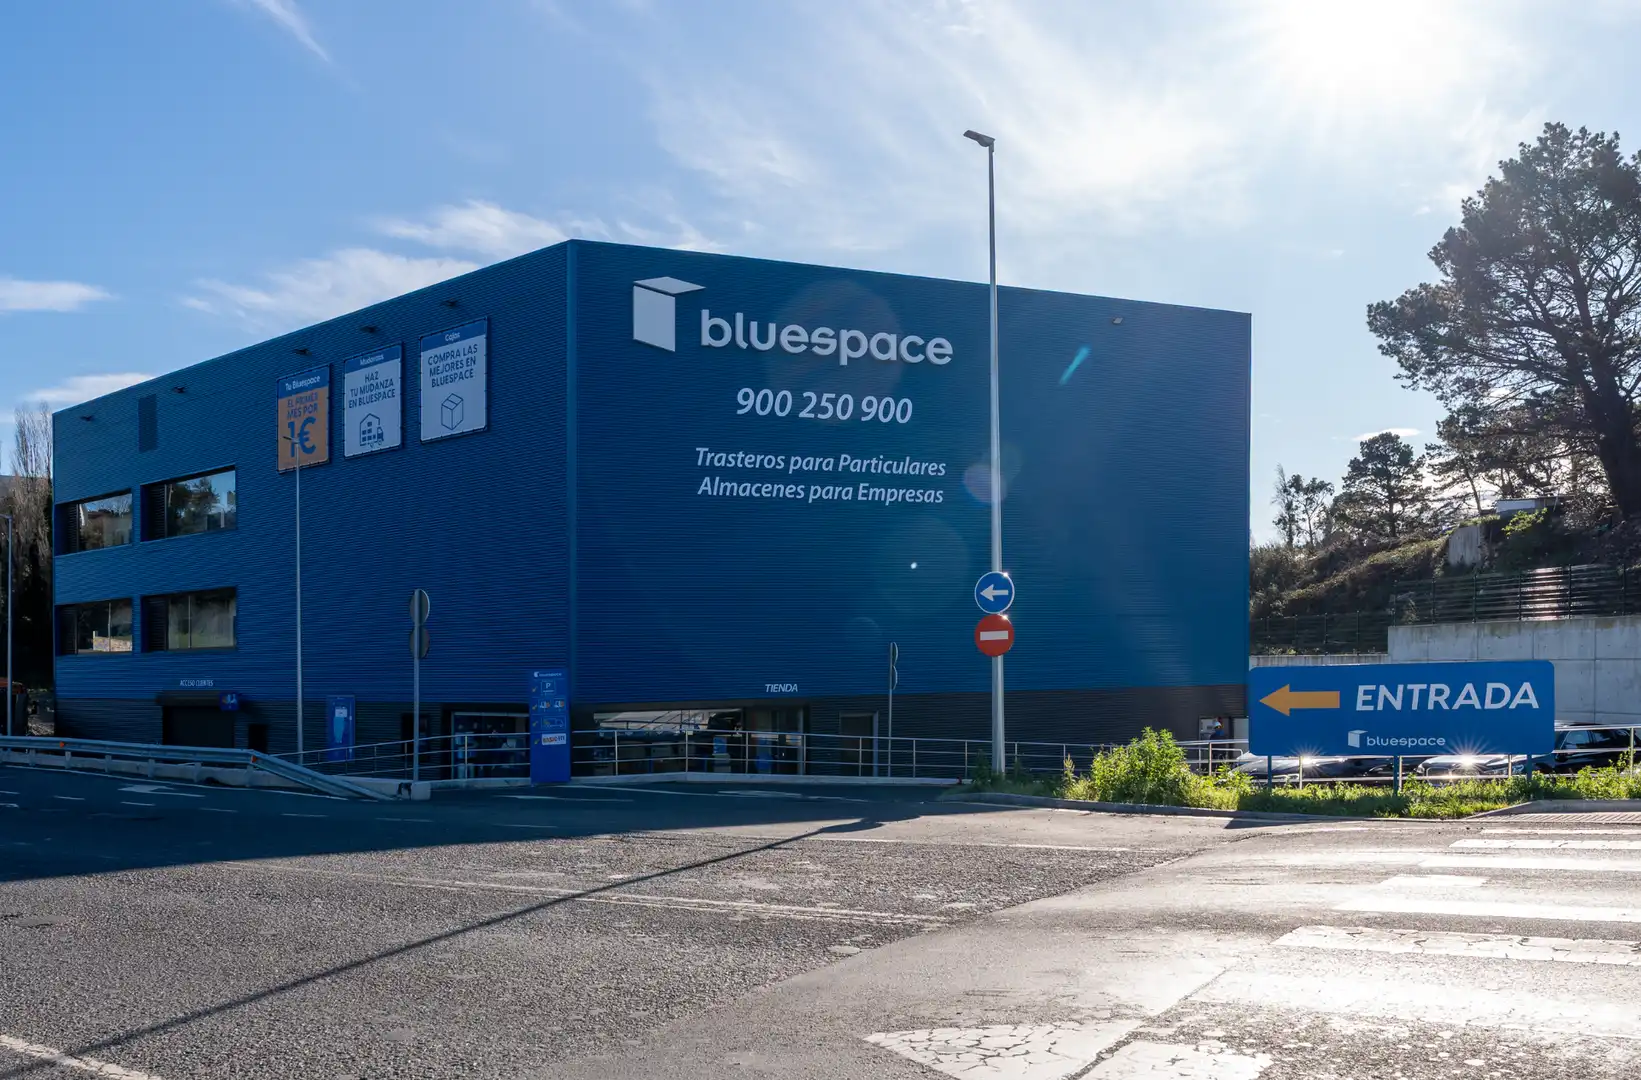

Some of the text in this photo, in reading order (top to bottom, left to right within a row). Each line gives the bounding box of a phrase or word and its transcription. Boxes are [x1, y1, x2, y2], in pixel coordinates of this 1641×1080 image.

[701, 308, 954, 366] bluespace
[427, 343, 478, 366] COMPRA LAS
[364, 370, 379, 383] HAZ
[429, 355, 477, 378] MEJORES EN
[285, 375, 321, 391] Tu Bluespace
[350, 378, 394, 398] TU MUDANZA
[431, 368, 474, 388] BLUESPACE
[287, 398, 294, 408] EL
[348, 388, 396, 409] EN BLUESPACE
[736, 387, 913, 424] 900 250 900
[287, 403, 318, 420] MES POR
[287, 416, 317, 458] 1€
[695, 447, 947, 477] Trasteros para Particulares
[697, 476, 944, 506] Almacenes para Empresas
[179, 679, 196, 687] ACCESO
[765, 683, 798, 693] TIENDA
[1355, 681, 1540, 712] ENTRADA
[1366, 733, 1446, 749] bluespace
